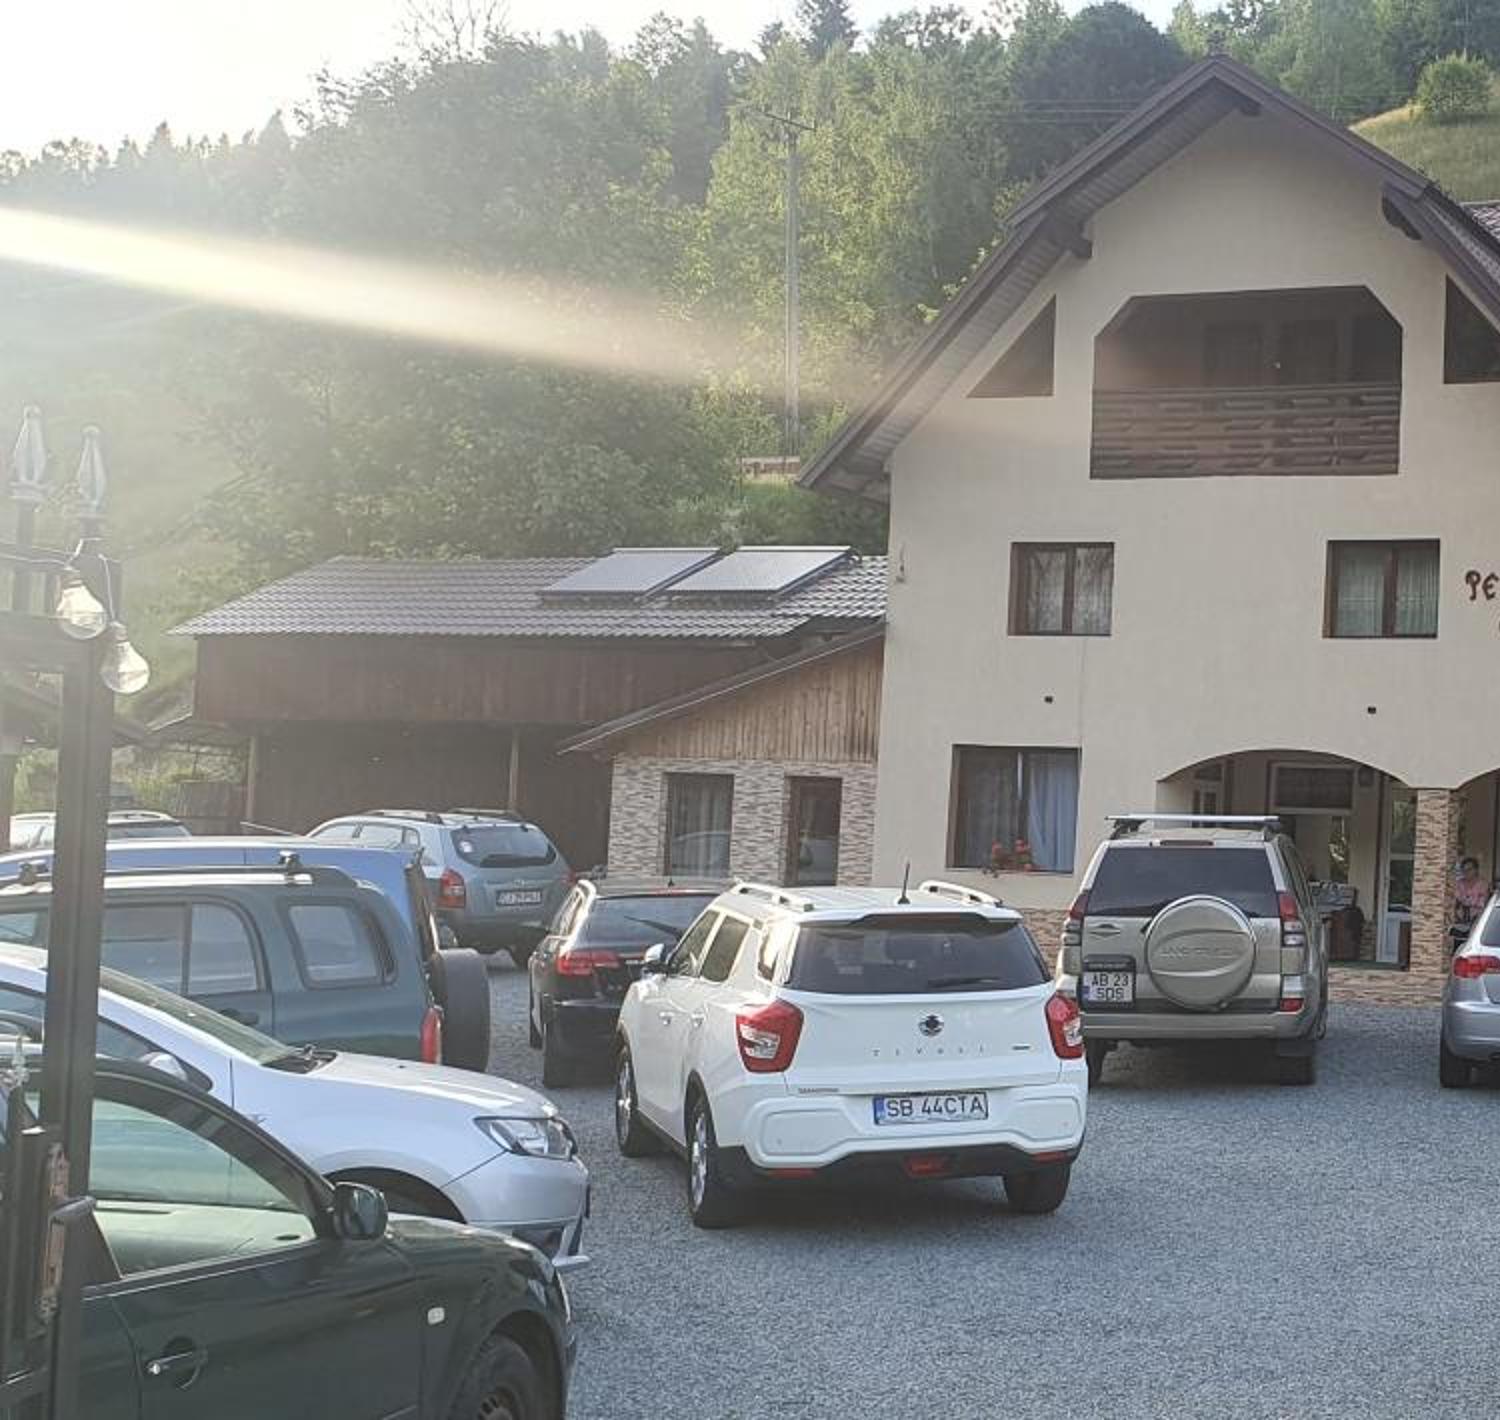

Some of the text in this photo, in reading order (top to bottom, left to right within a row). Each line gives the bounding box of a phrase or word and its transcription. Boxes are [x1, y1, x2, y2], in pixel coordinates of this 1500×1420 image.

[1091, 973, 1129, 987] AB 23
[886, 1099, 914, 1117] SB
